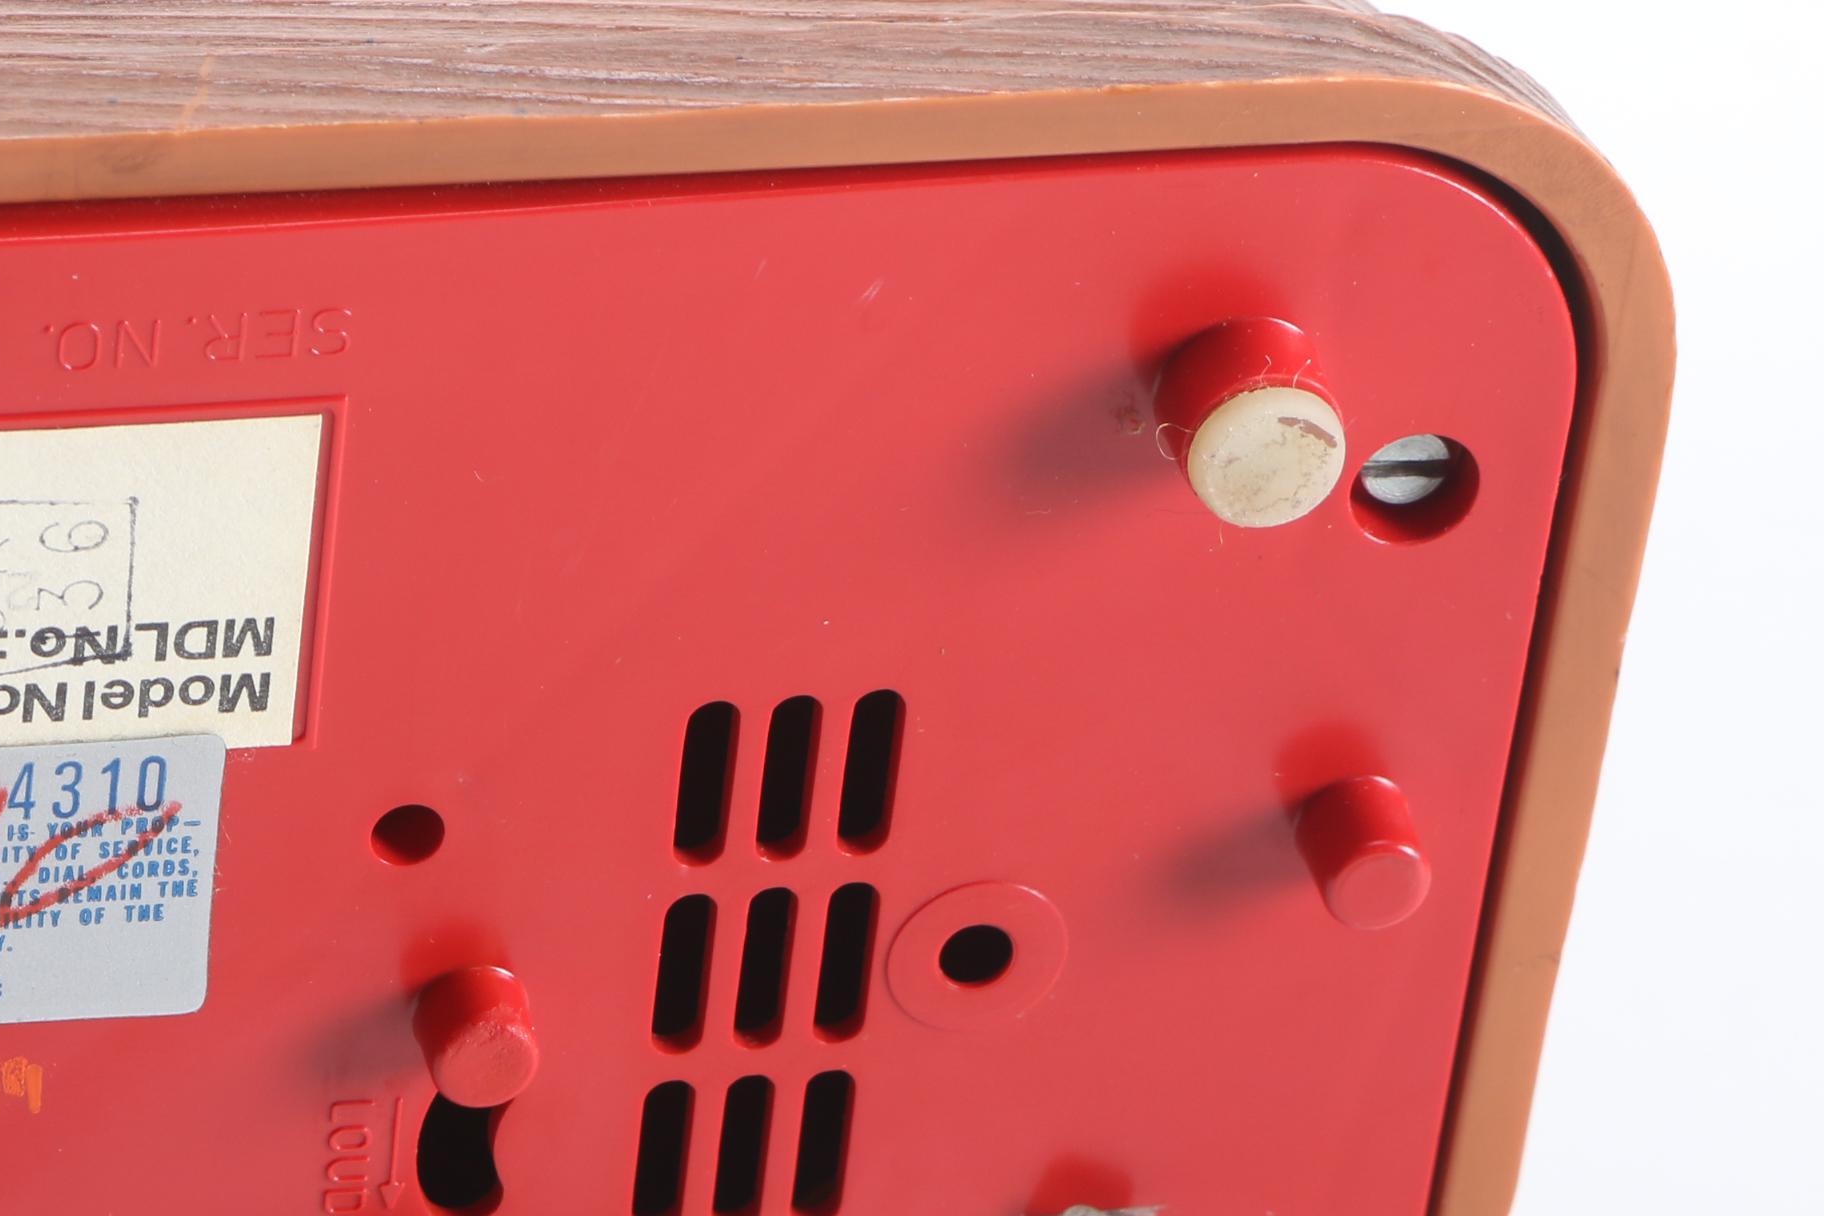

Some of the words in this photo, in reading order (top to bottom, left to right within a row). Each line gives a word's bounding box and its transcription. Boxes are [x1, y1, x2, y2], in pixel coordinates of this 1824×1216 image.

[42, 318, 162, 371] NO.
[186, 306, 352, 363] SER.
[135, 616, 275, 662] MDL
[82, 671, 271, 720] Model
[47, 819, 104, 840] YOUR
[55, 843, 82, 861] OF
[117, 858, 199, 879] CORDS,
[157, 878, 199, 898] THE
[79, 907, 106, 926] OF
[124, 903, 165, 922] THE
[322, 1099, 376, 1213] LOUD
